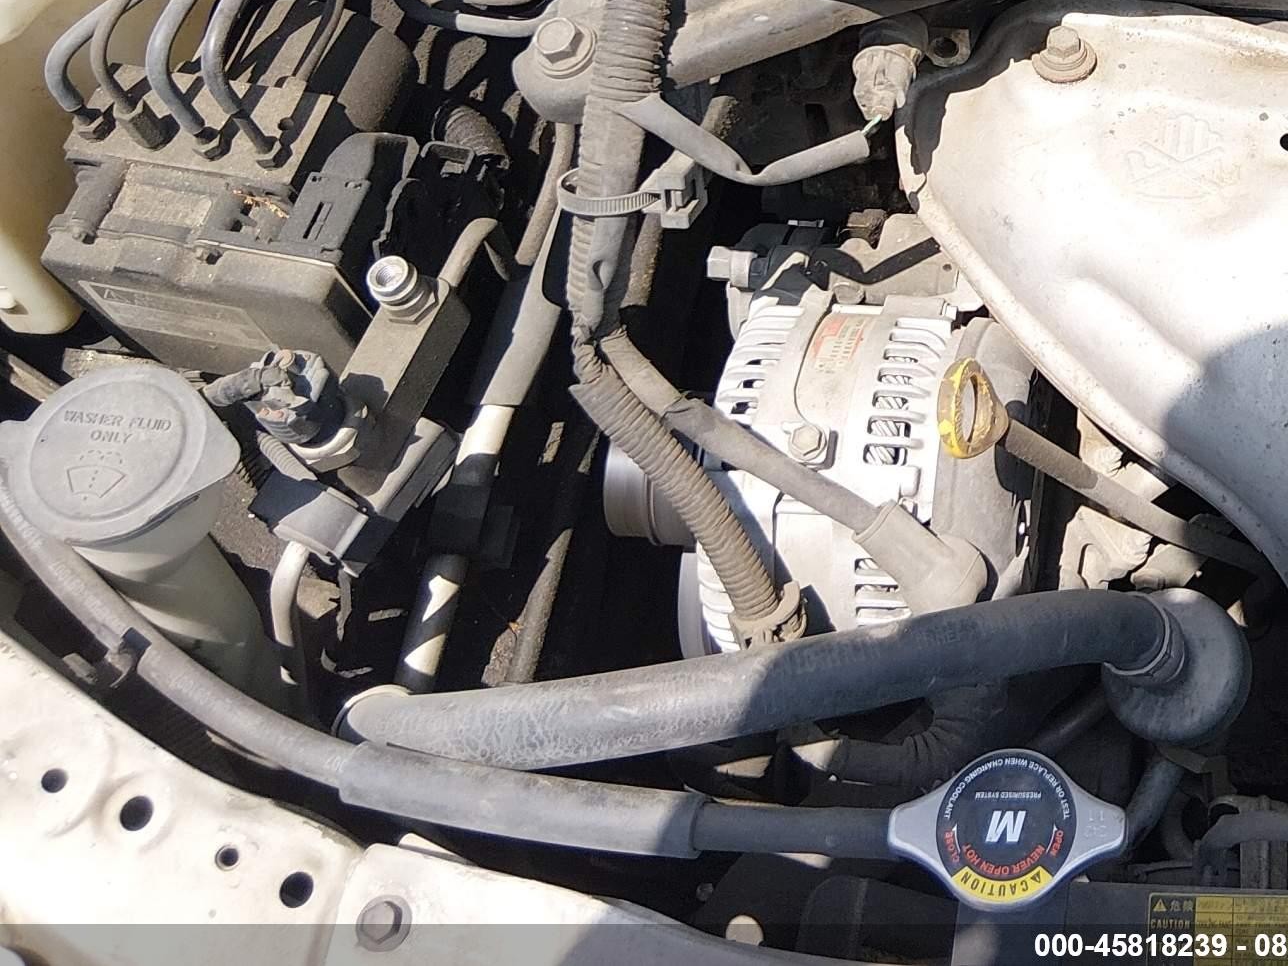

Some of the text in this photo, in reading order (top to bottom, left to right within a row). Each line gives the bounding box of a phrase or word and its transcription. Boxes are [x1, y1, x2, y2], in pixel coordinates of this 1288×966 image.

[63, 409, 172, 432] WASHER FLUID
[90, 429, 133, 444] ONLY
[944, 757, 1071, 820] TEST OR REPLACE WHEN CHANGING COOLANT
[974, 791, 1042, 800] PRESSURISED SYSTEM
[984, 810, 1027, 843] M
[944, 831, 961, 864] CLOSE
[1050, 830, 1064, 857] OPEN
[962, 843, 1046, 876] NEVER OPEN HOT
[960, 871, 1029, 897] CAUTION
[1149, 919, 1191, 930] CAUTION
